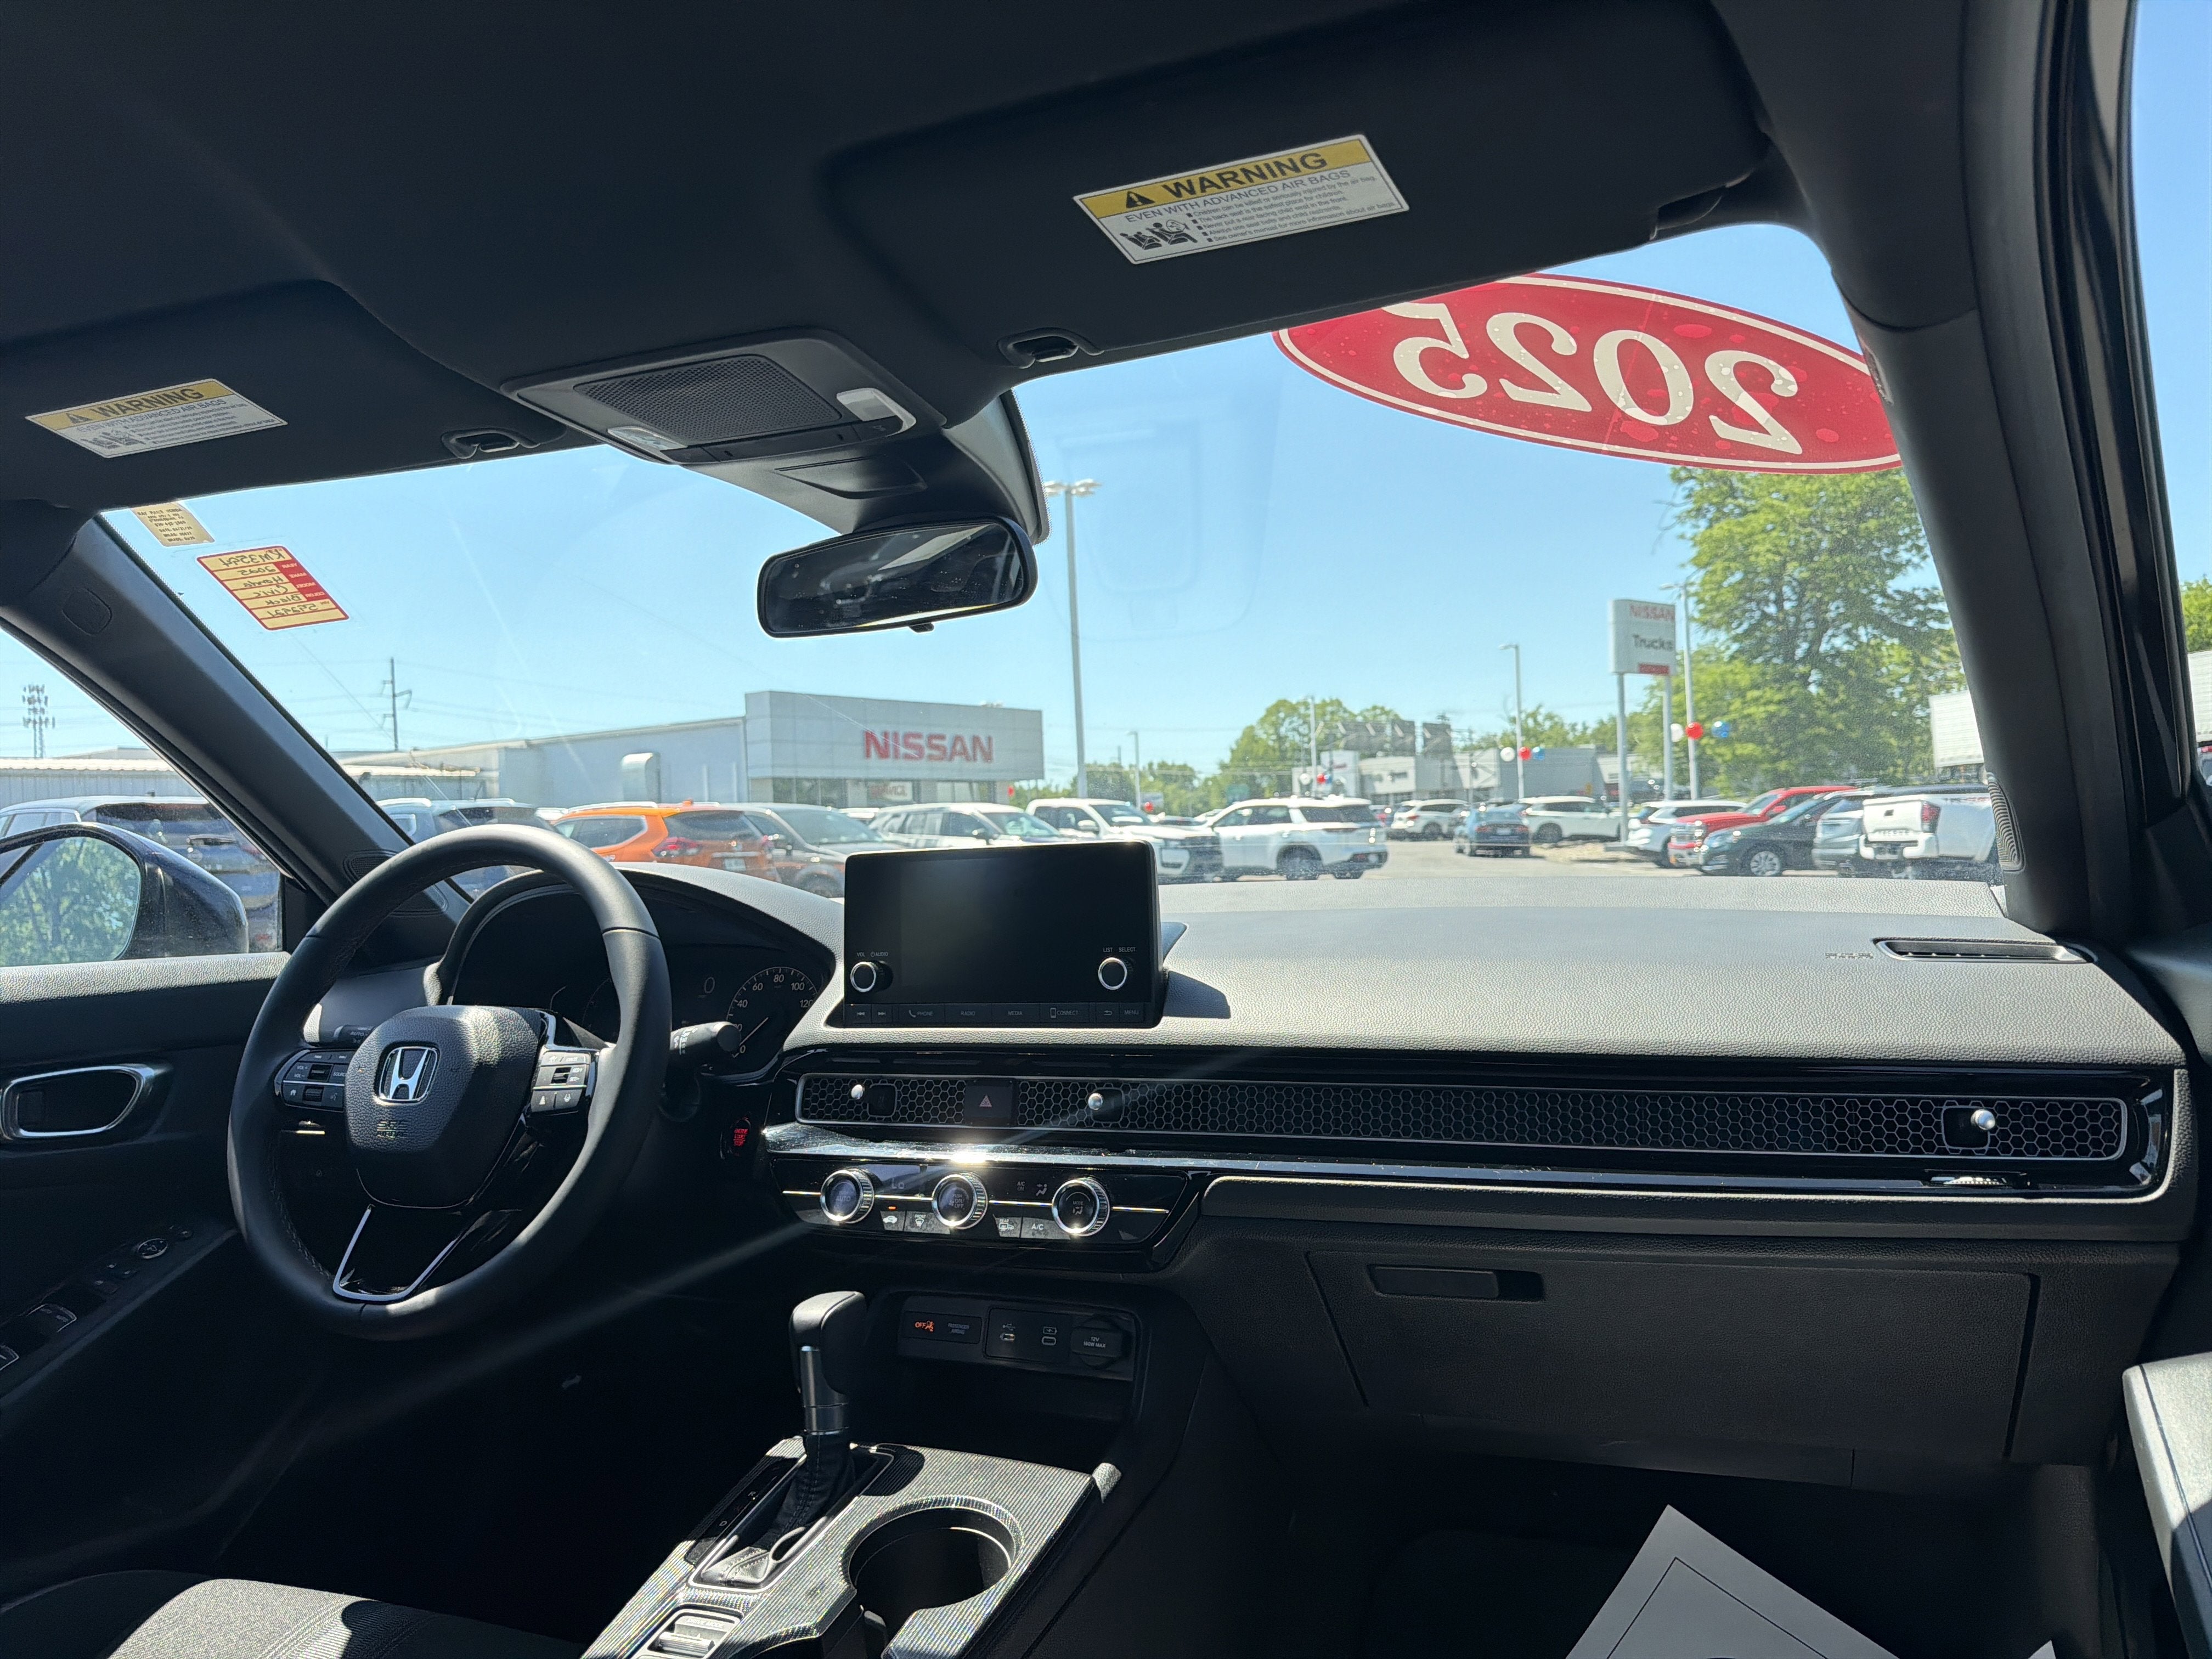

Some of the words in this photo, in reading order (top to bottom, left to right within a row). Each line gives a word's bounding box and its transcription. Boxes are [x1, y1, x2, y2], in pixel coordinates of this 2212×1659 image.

[1162, 152, 1328, 198] WARNING
[1126, 210, 1163, 222] EVEN
[1165, 202, 1199, 214] WITH
[1202, 186, 1278, 206] ADVANCED
[1281, 180, 1305, 190] AIR
[1309, 171, 1350, 184] BAGS
[92, 388, 204, 419] WARNING
[76, 424, 105, 432] EVEN
[101, 419, 131, 427] WITH
[126, 408, 182, 422] ADVANCED
[196, 399, 228, 408] BAGS
[863, 729, 994, 763] NISSAN
[752, 983, 763, 991] 60
[774, 974, 785, 983] 80
[791, 983, 805, 991] 100
[737, 1000, 748, 1008] 40
[740, 1045, 746, 1053] 0
